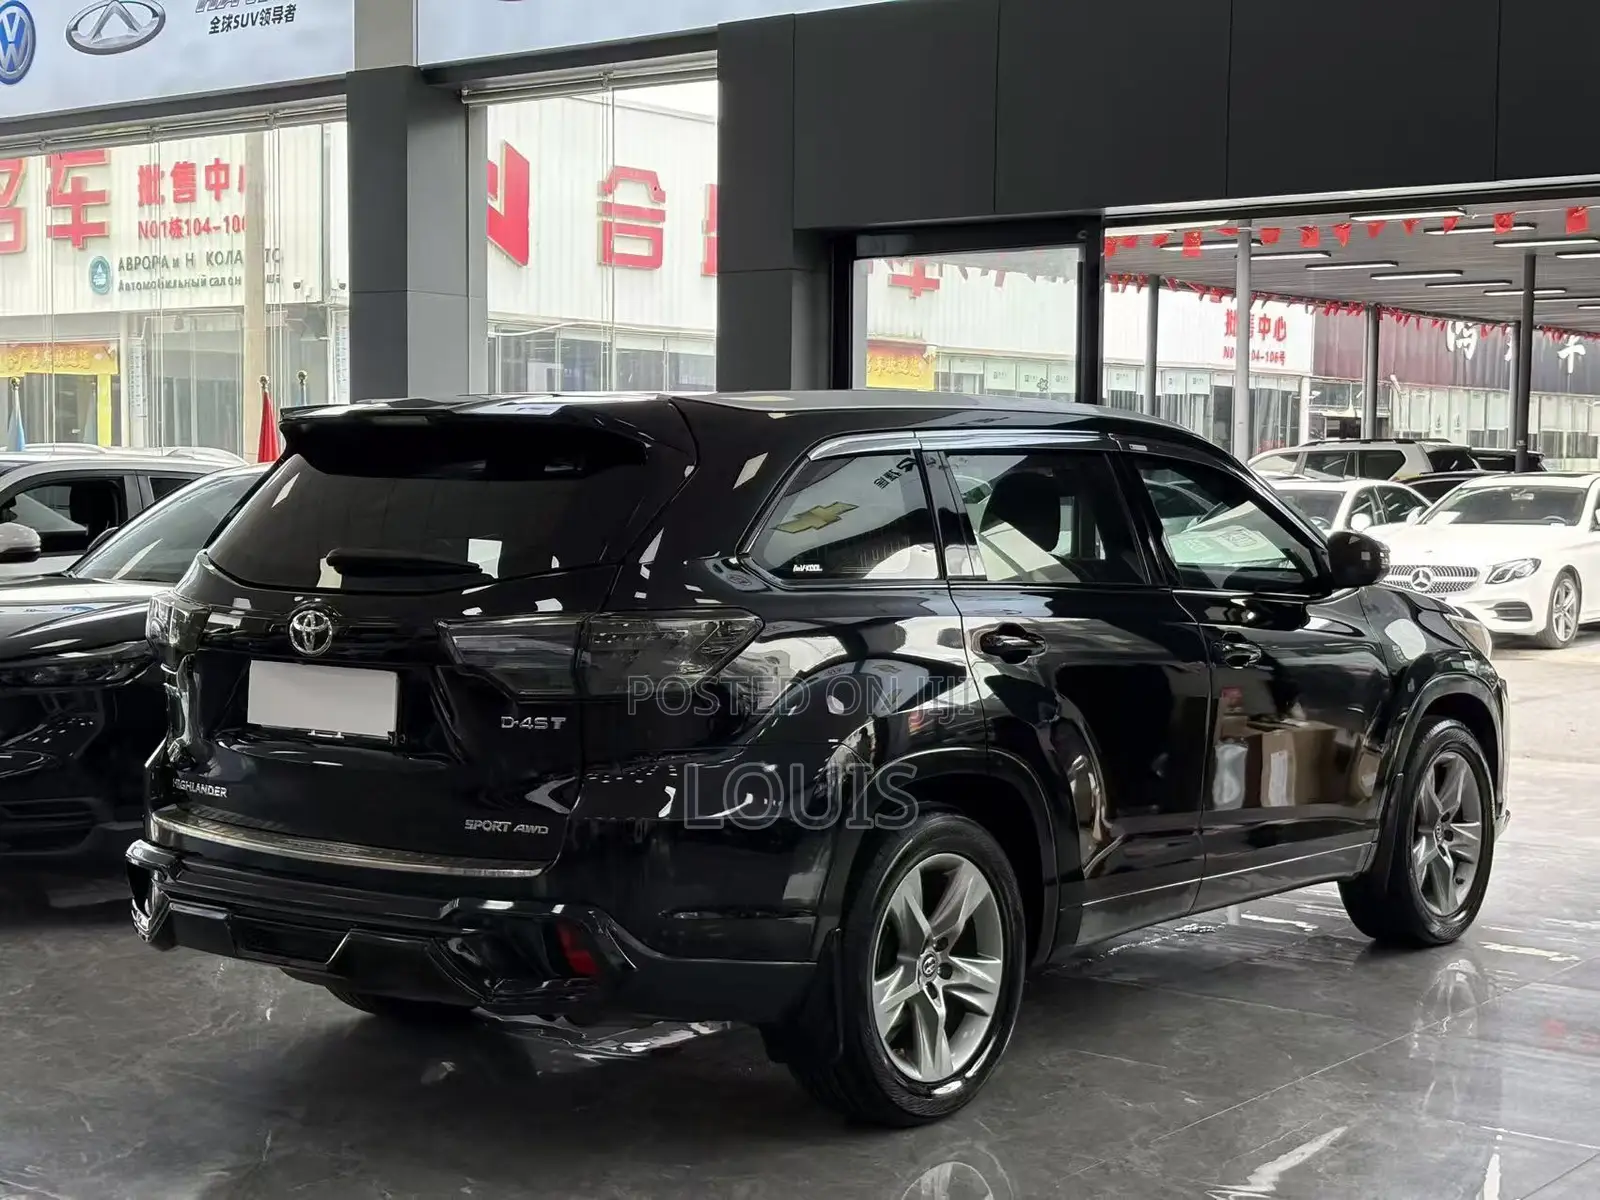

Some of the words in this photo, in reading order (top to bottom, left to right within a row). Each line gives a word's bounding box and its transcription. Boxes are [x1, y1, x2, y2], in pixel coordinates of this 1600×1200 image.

[208, 3, 297, 34] 全球SUV领导者
[138, 157, 246, 207] 批售中
[172, 778, 228, 798] HIGHLANDER
[464, 819, 512, 832] SPORT
[513, 824, 549, 834] AWD
